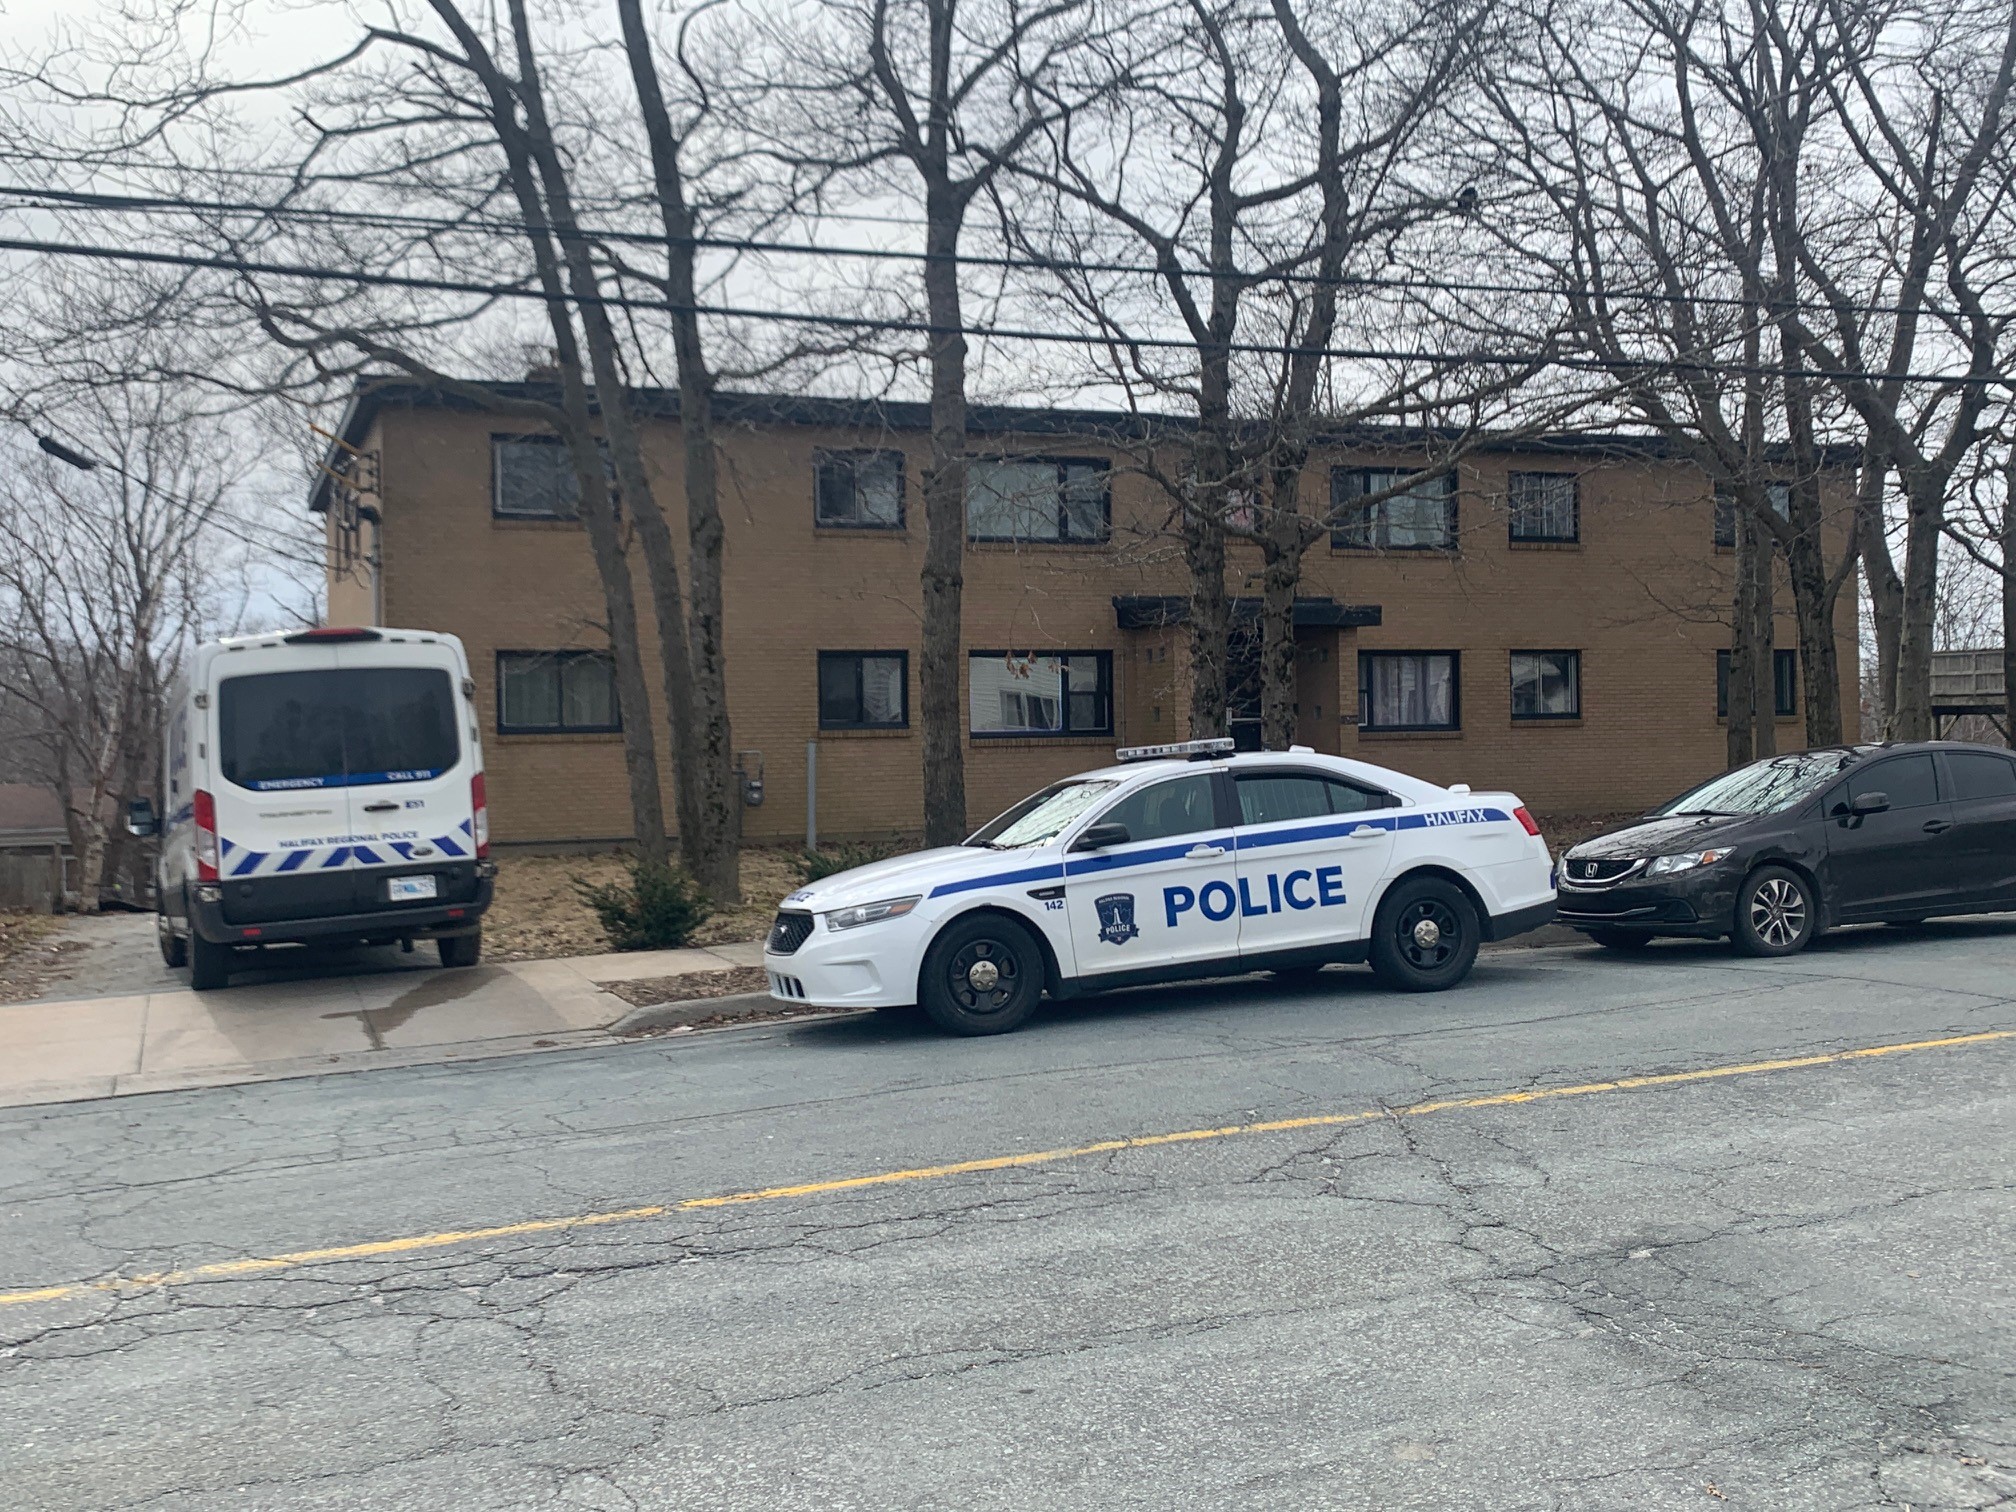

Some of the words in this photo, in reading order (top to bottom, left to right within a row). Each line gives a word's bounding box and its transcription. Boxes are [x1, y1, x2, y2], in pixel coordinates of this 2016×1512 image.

[258, 778, 324, 790] EMERGENCY
[386, 771, 413, 780] CALL
[415, 770, 431, 779] 911
[1424, 809, 1487, 826] HALIFAX
[279, 838, 324, 847] HALIFAX
[327, 834, 378, 843] REGIONAL
[381, 830, 418, 839] POLICE
[1163, 865, 1346, 928] POLICE
[1045, 900, 1064, 911] 142
[1105, 924, 1131, 935] POLICE
